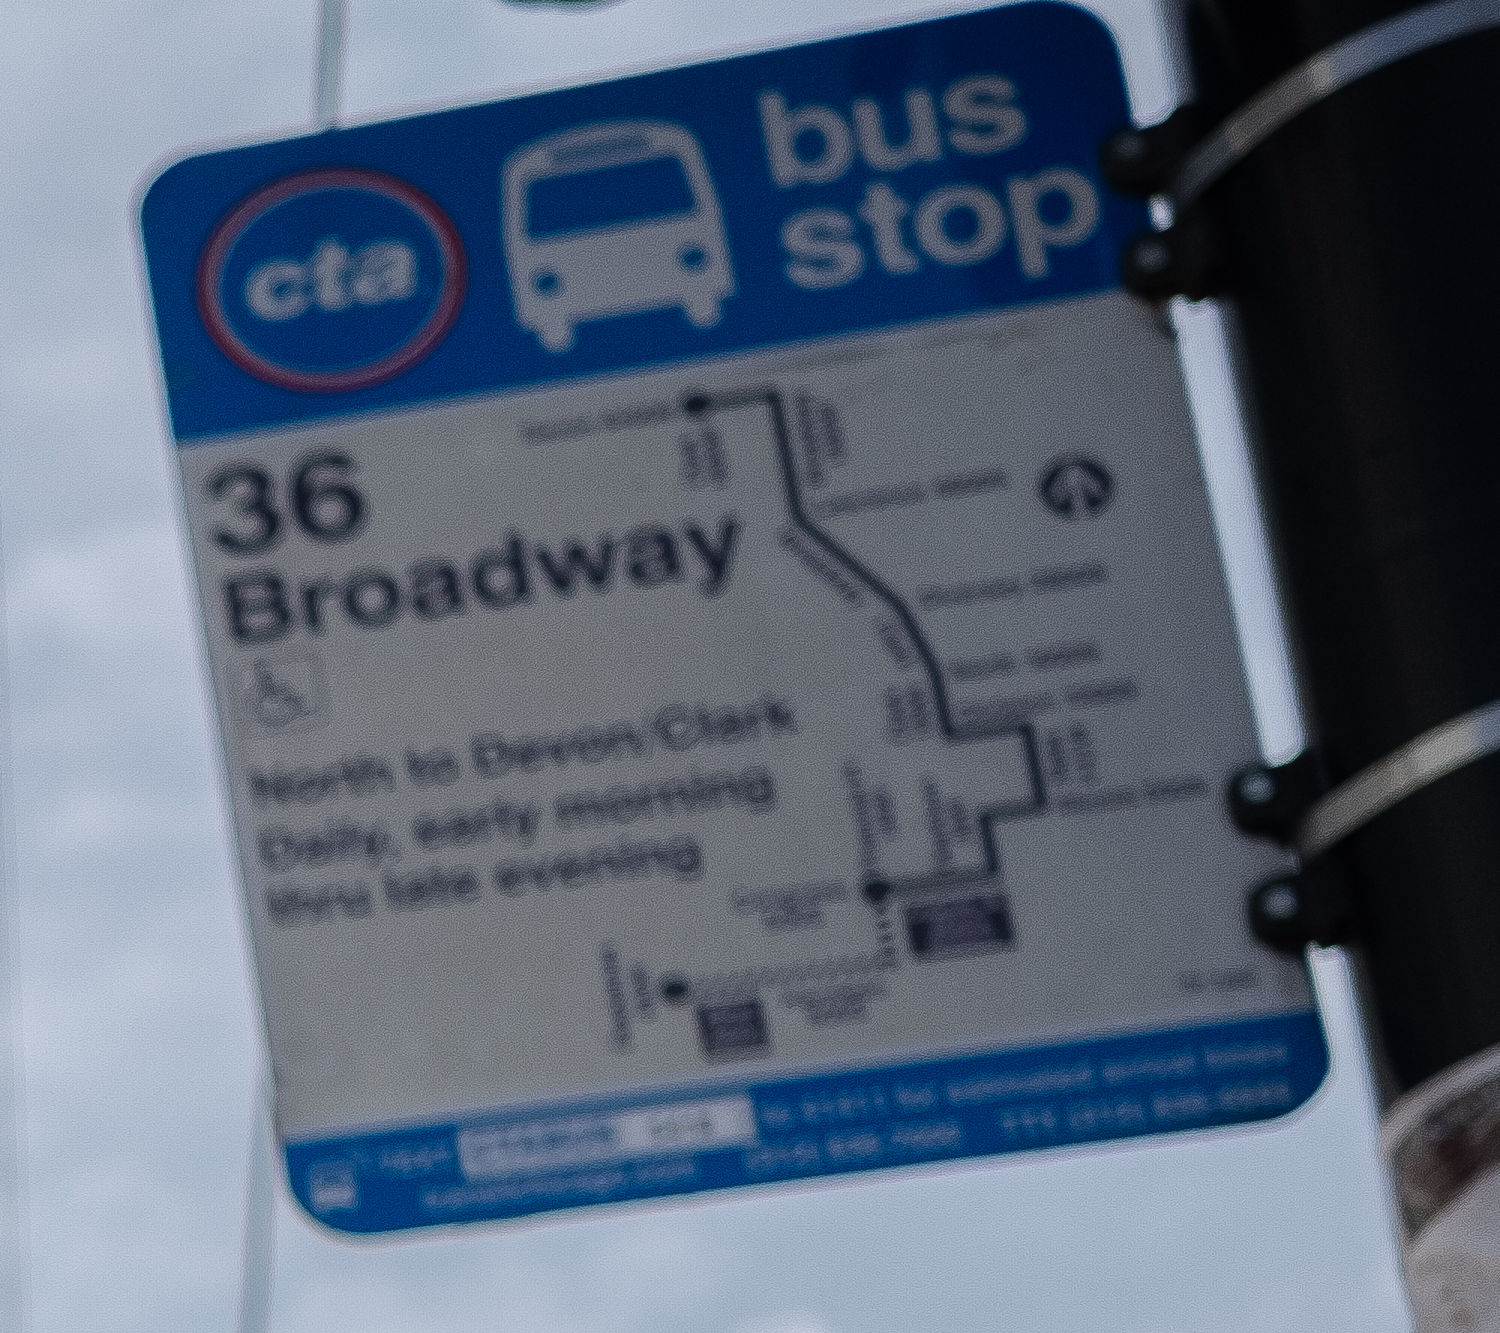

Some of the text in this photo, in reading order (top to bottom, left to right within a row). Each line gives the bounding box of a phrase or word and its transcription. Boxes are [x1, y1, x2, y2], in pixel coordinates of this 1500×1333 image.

[758, 73, 1029, 191] bus
[782, 166, 1100, 292] stop
[245, 236, 418, 323] cta
[205, 447, 367, 557] 36
[220, 508, 742, 647] Broadway
[251, 752, 393, 805] North
[408, 743, 460, 784] to
[385, 867, 481, 910] late
[497, 834, 703, 893] evening
[414, 802, 539, 853] early
